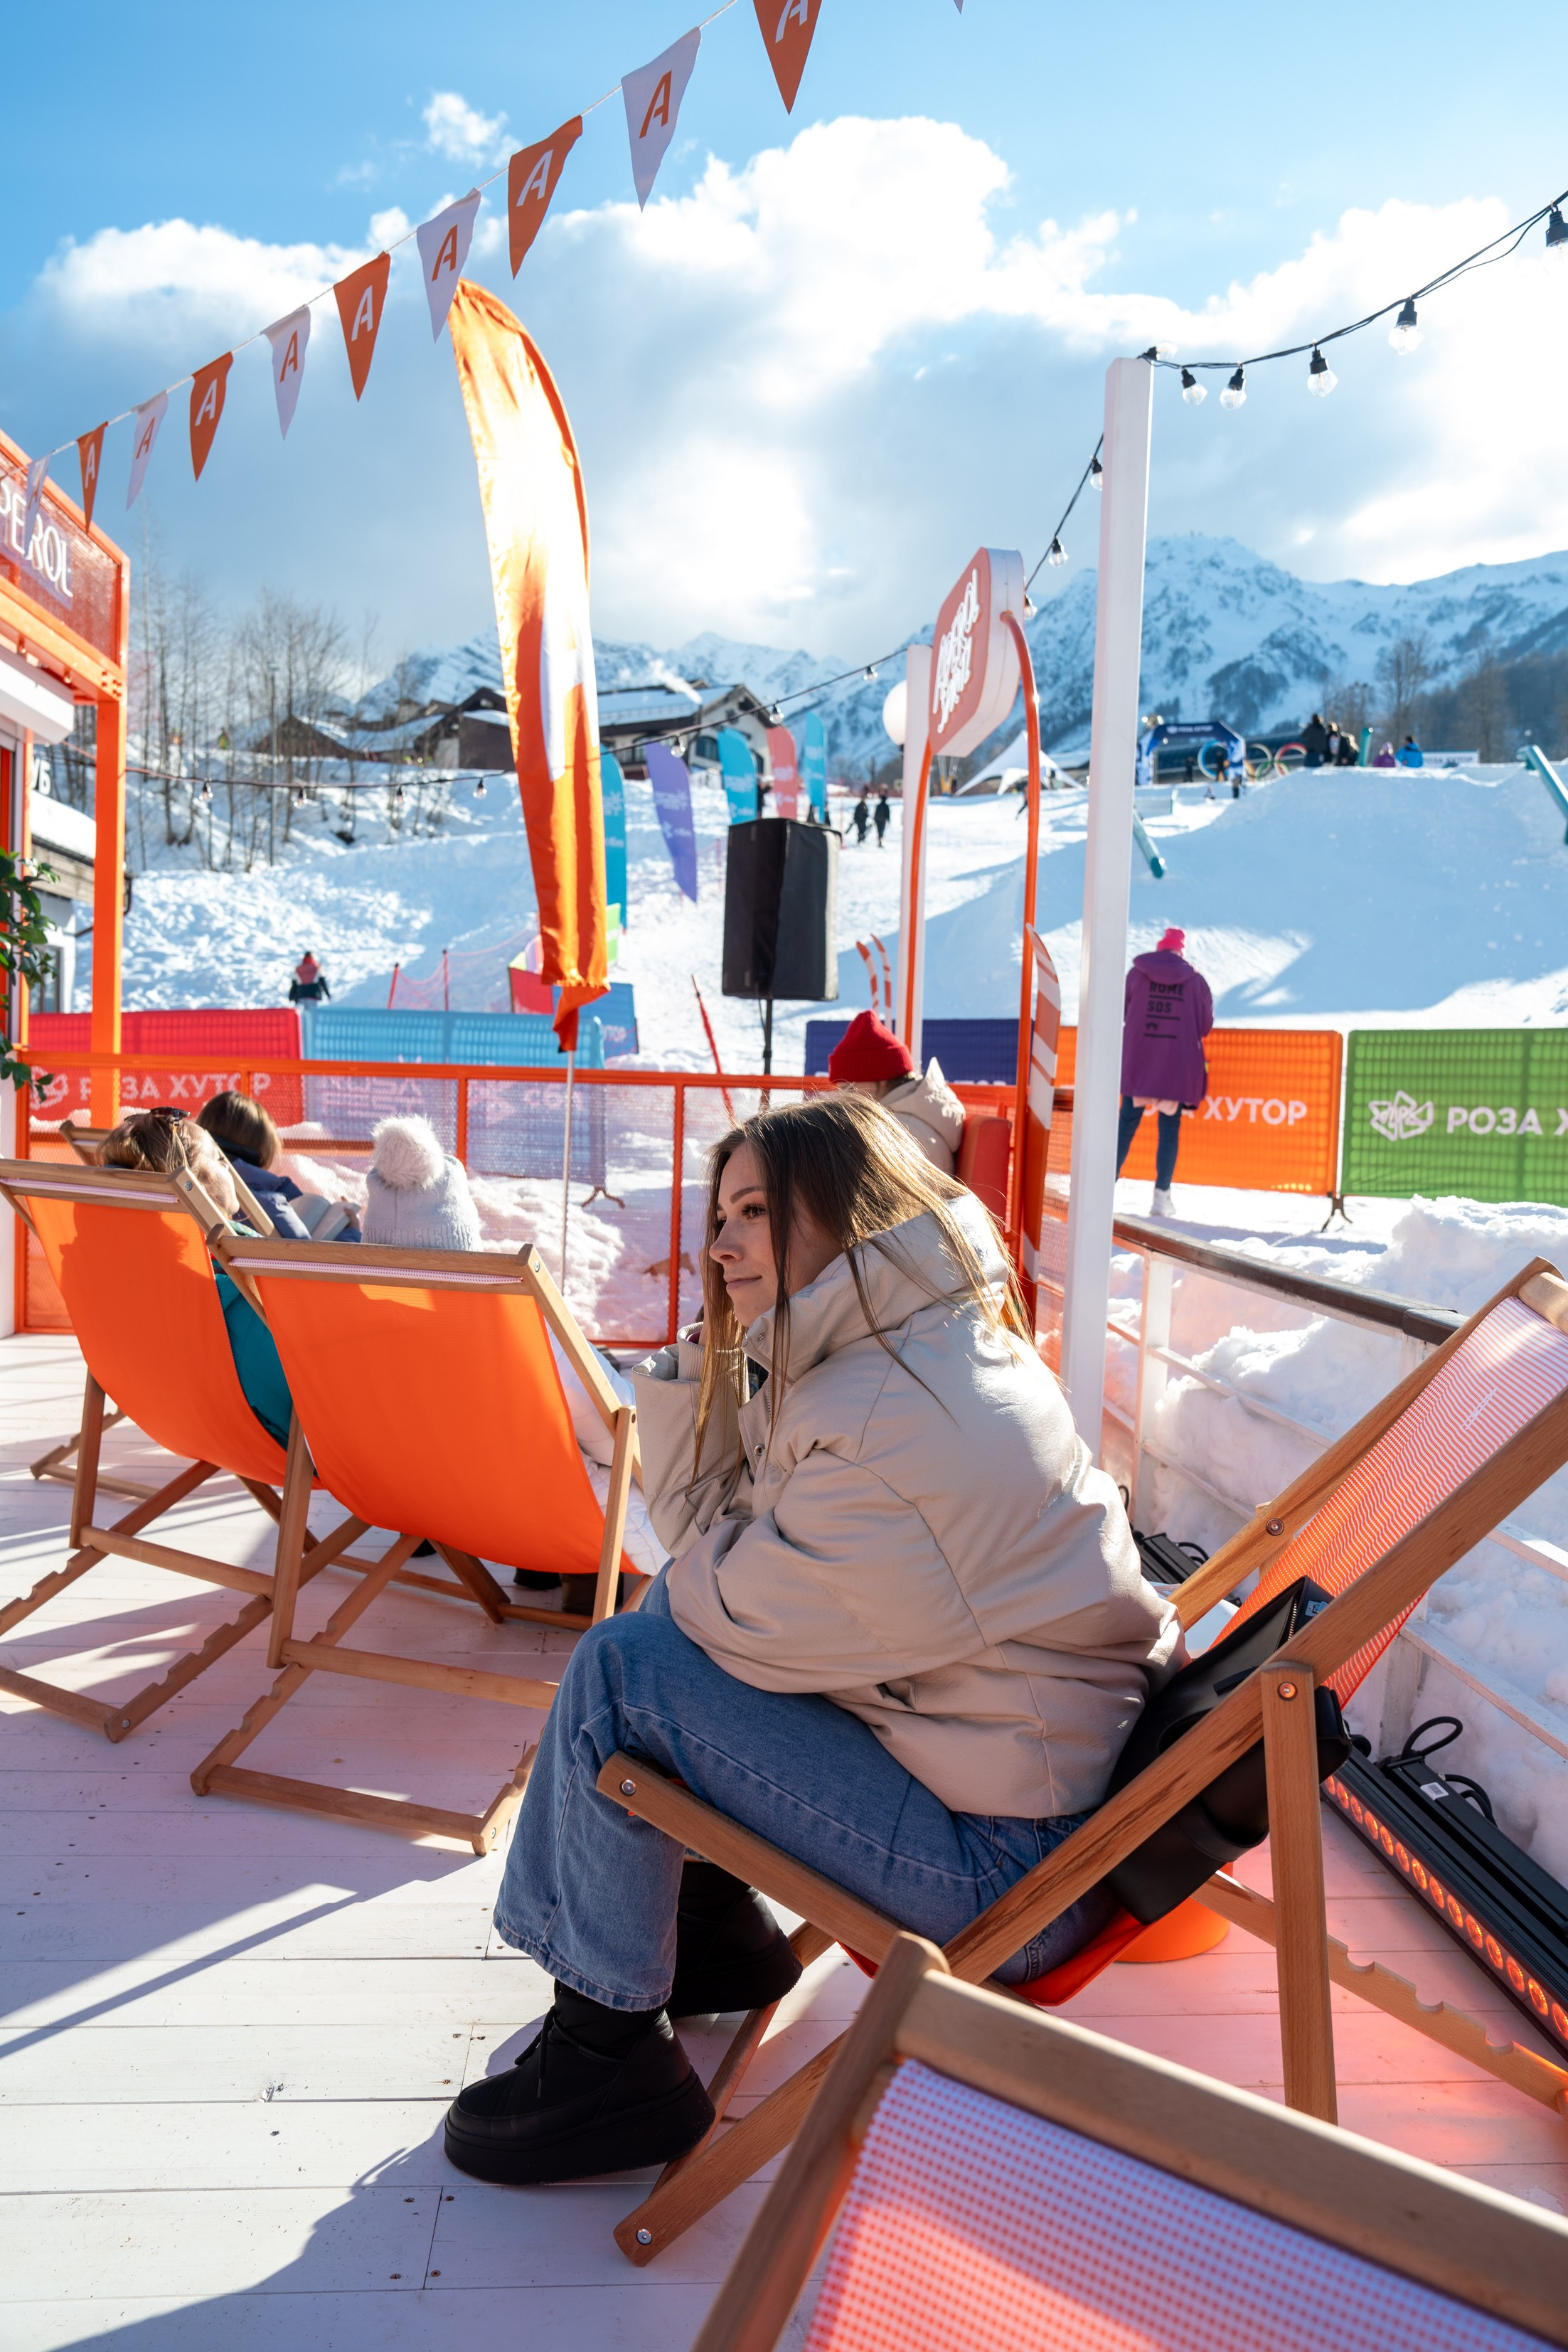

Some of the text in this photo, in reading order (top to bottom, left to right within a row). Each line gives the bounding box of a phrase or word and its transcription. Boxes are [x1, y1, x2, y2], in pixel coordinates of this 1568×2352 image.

[639, 70, 672, 139] A
[516, 149, 554, 208] A
[431, 224, 458, 282] A
[351, 284, 373, 342] A
[279, 330, 299, 383] A
[194, 378, 218, 427] A
[135, 416, 156, 459] A
[84, 442, 95, 489] A
[80, 1075, 161, 1100] РЗА
[1203, 1095, 1308, 1126] ХУТОР
[1446, 1106, 1543, 1136] РОЗА
